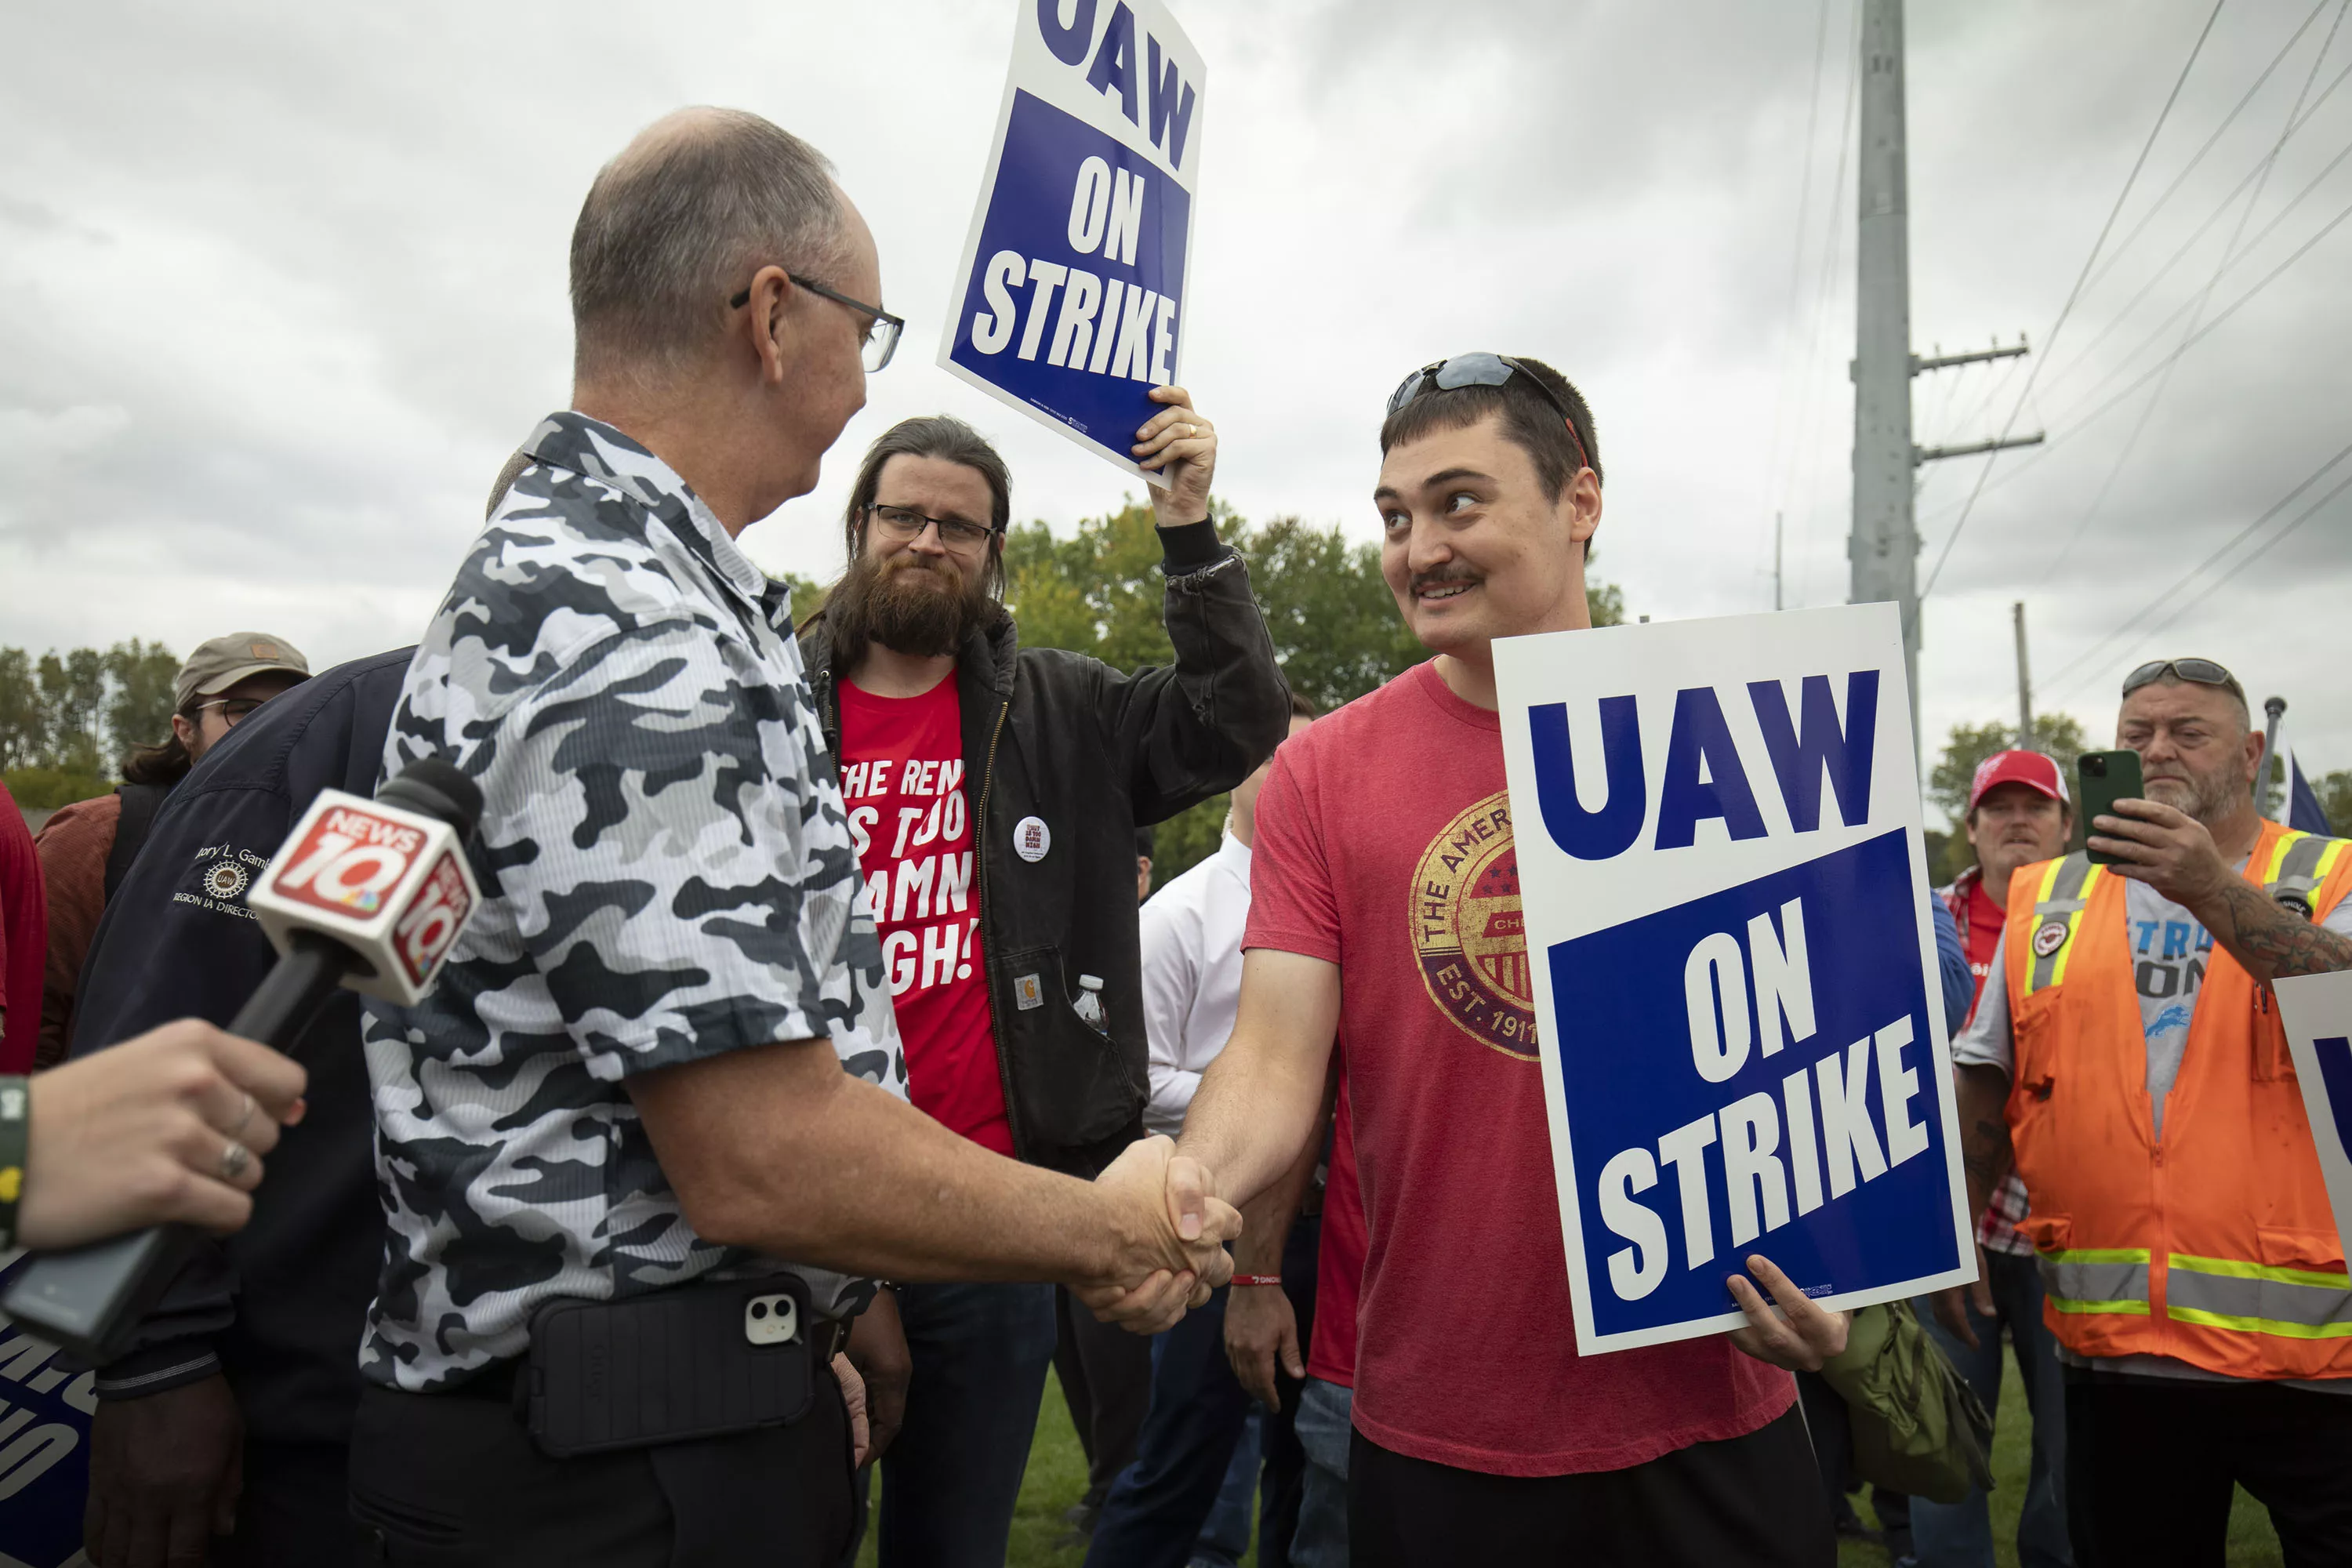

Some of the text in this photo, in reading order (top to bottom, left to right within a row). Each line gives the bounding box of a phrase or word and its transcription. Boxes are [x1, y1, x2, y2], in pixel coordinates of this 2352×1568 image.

[1036, 0, 1196, 172] UAW
[1068, 155, 1145, 267] ON
[971, 249, 1176, 387] STRIKE
[900, 758, 964, 796] REN
[1528, 669, 1881, 861] UAW
[238, 848, 271, 871] Gamb
[279, 831, 407, 902] 10
[325, 808, 421, 854] NEWS
[848, 805, 879, 858] S
[172, 892, 203, 906] REGION
[216, 874, 236, 886] UAW
[867, 851, 973, 924] AMN
[1420, 808, 1512, 943] THE AMER
[881, 918, 980, 996] GH!
[1684, 896, 1817, 1083] ON
[1436, 963, 1537, 1044] EST. 1911
[1598, 1014, 1929, 1302] STRIKE
